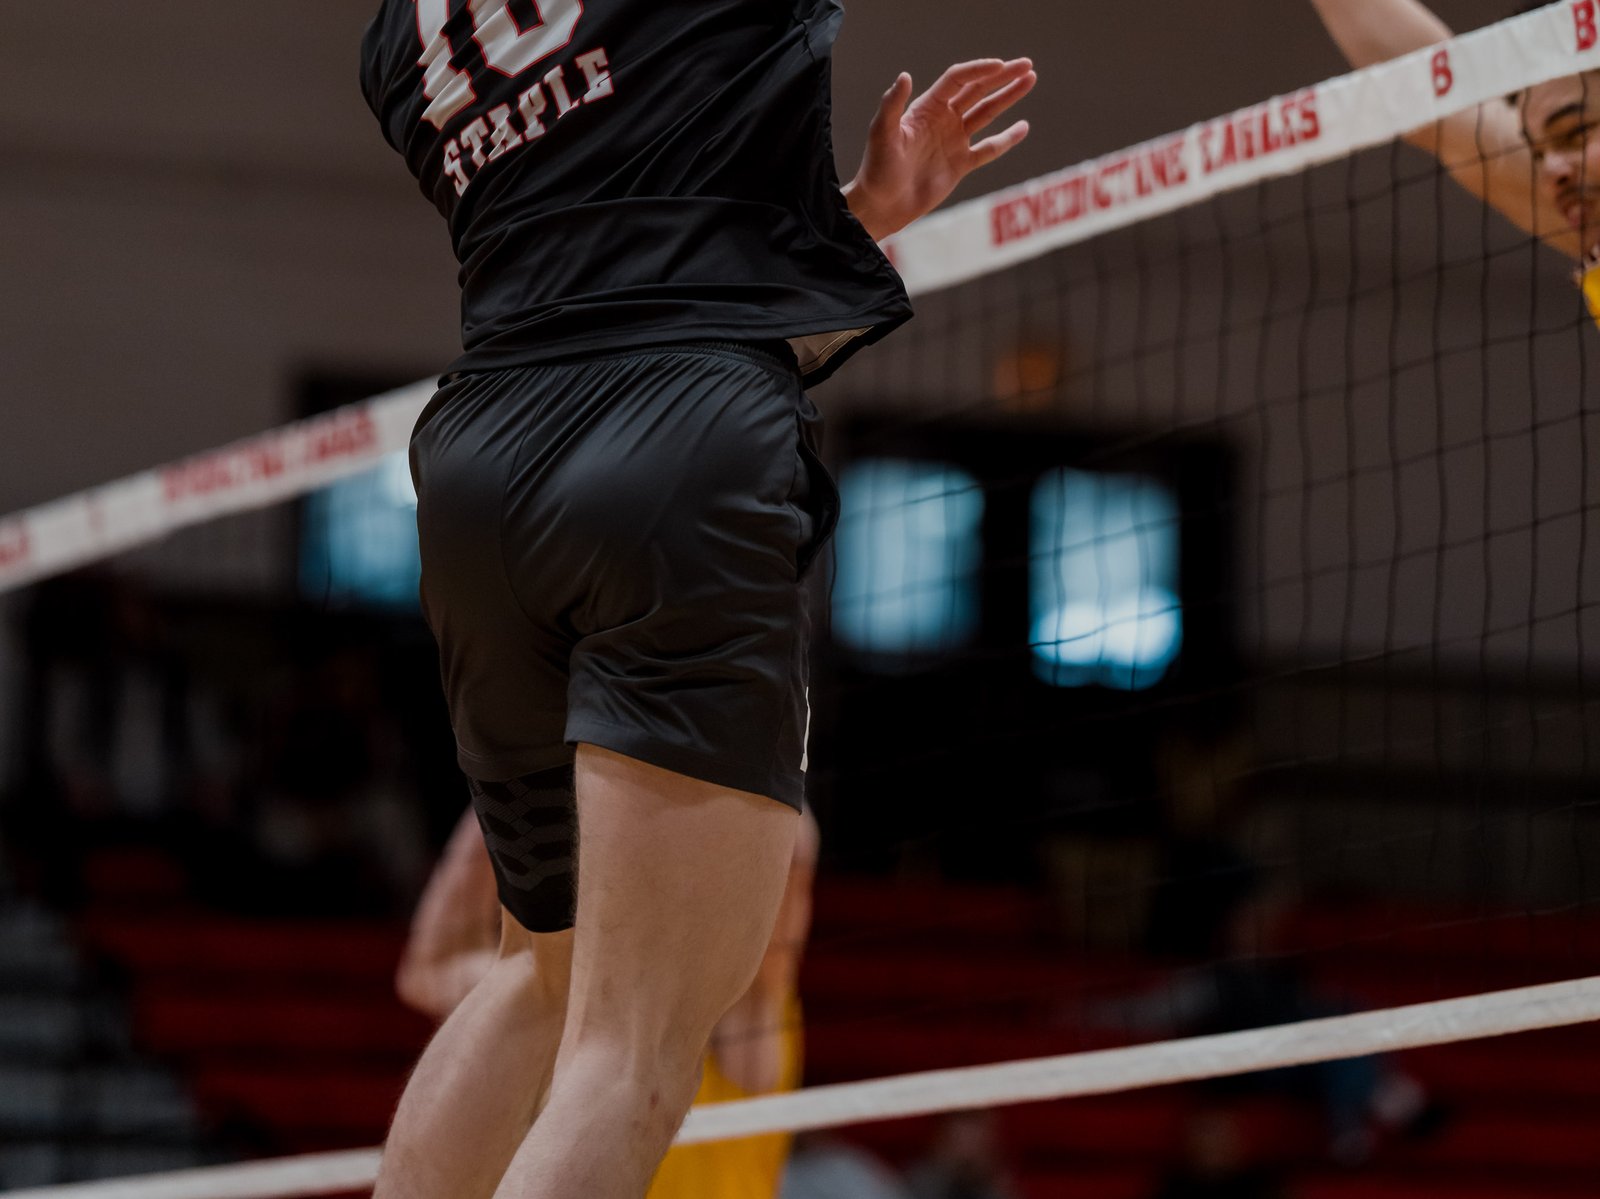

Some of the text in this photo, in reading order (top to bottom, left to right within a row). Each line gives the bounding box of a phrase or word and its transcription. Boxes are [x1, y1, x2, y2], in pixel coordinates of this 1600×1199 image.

[1430, 49, 1454, 98] B
[443, 47, 615, 199] STAPLE
[1199, 88, 1322, 175] EAGLES
